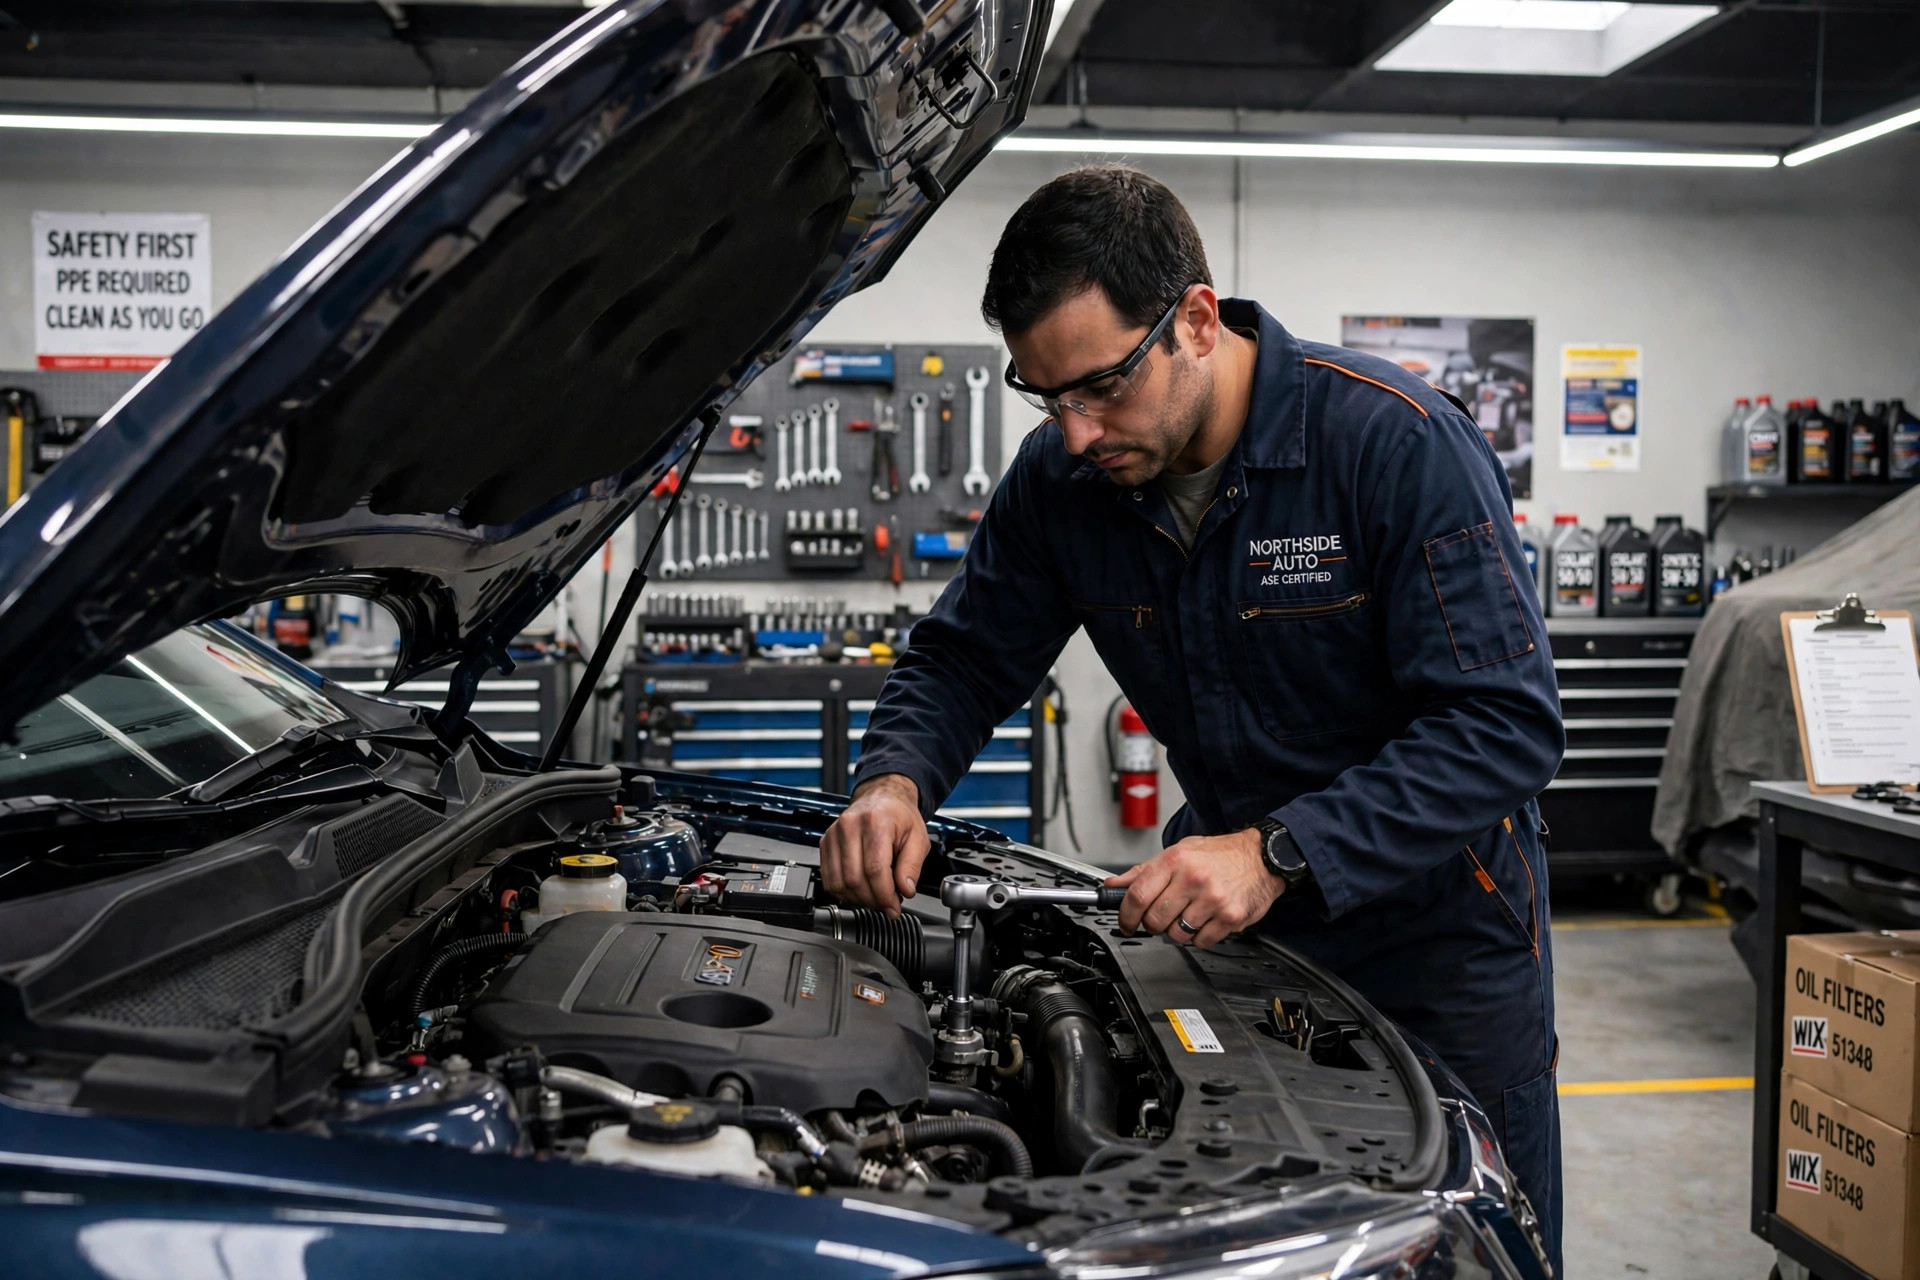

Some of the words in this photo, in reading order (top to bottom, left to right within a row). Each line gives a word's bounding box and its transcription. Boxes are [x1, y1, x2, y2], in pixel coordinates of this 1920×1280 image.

[48, 231, 129, 258] SAFETY
[137, 233, 197, 259] FIRST
[57, 270, 91, 293] PPE
[97, 271, 190, 296] REQUIRED
[46, 305, 103, 328] CLEAN
[110, 306, 132, 329] AS
[138, 307, 173, 330] YOU
[179, 308, 204, 330] GO
[1249, 535, 1342, 556] NORTHSIDE
[1272, 554, 1318, 571] AUTO
[1261, 575, 1279, 586] ASE
[1281, 572, 1332, 585] CERTIFIED
[1796, 967, 1819, 1000] OIL
[1823, 979, 1885, 1027] FILTERS
[1794, 1020, 1825, 1048] WIX
[1832, 1033, 1873, 1072] 51348
[1790, 1099, 1813, 1135] OIL
[1817, 1114, 1876, 1168] FILTERS
[1788, 1152, 1819, 1184] WIX
[1825, 1170, 1863, 1211] 51348
